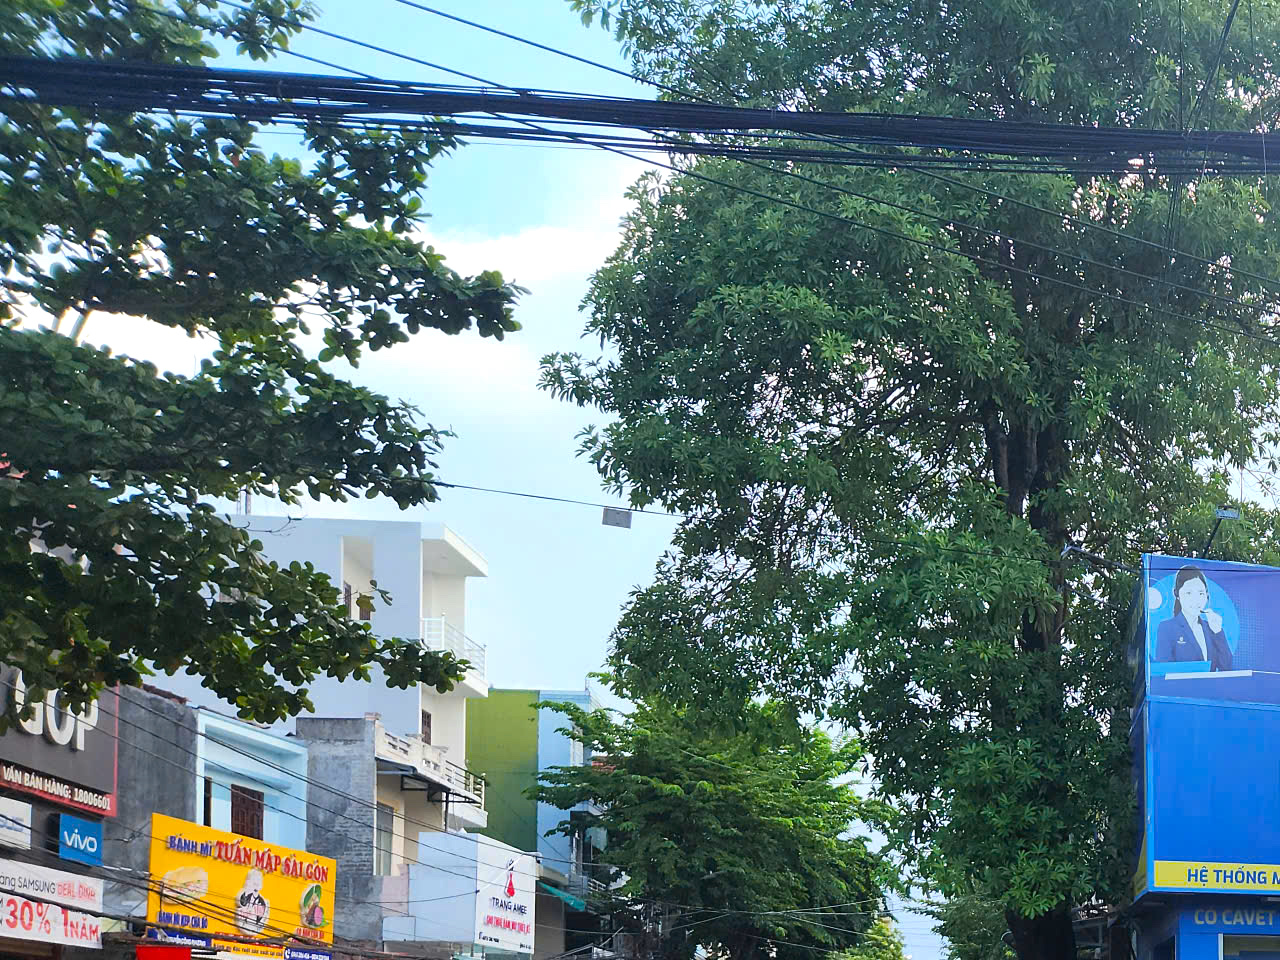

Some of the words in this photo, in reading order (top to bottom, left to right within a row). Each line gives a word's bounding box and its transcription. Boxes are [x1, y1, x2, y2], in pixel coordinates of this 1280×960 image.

[64, 828, 98, 853] vivo
[17, 876, 56, 895] SAMSUNG
[1187, 866, 1209, 888] HỆ
[1213, 866, 1268, 886] THỐNG
[5, 898, 51, 934] 30%
